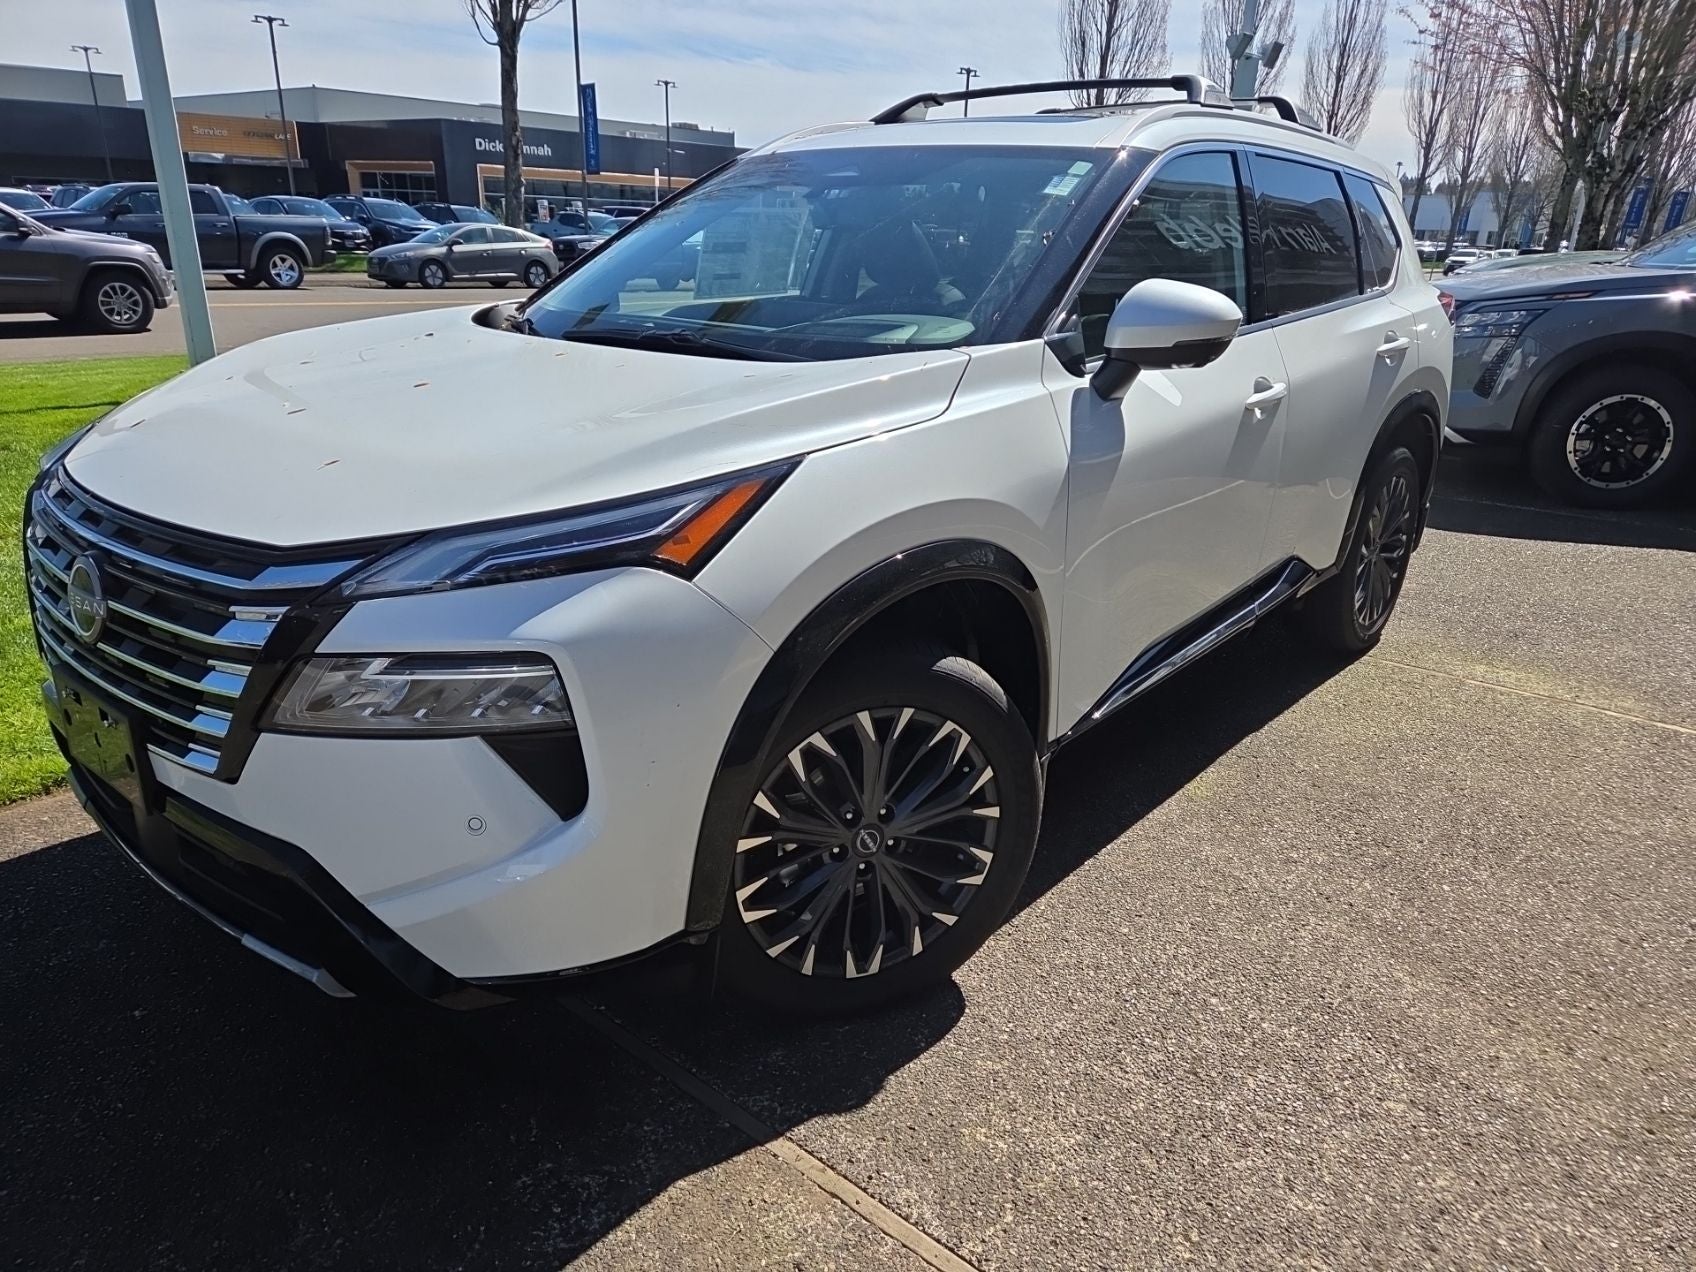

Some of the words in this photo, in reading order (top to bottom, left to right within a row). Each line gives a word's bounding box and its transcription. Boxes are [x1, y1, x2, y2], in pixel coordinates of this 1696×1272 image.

[192, 126, 228, 137] Service
[475, 137, 504, 152] Dick
[522, 143, 552, 157] nnah
